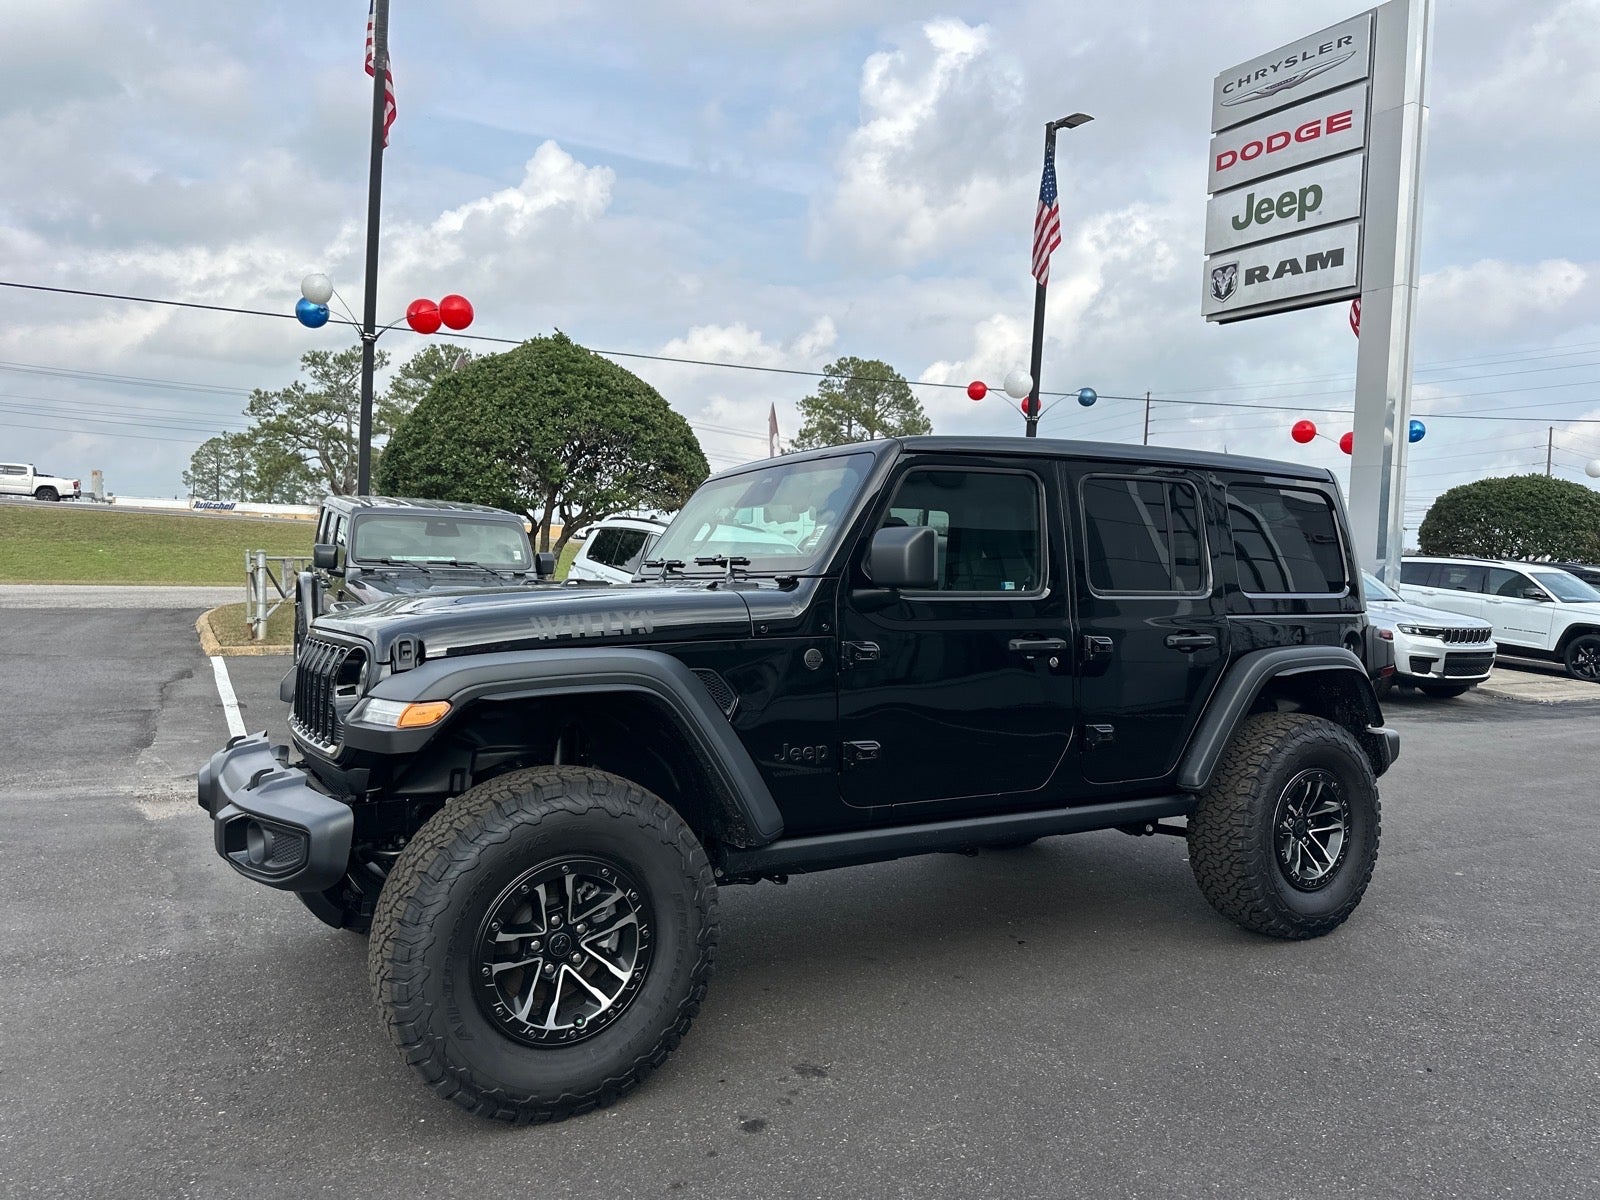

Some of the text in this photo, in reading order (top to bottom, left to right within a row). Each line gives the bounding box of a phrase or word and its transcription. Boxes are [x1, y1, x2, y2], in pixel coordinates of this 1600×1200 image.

[1222, 35, 1353, 94] CHRYSLER
[1216, 110, 1353, 172] DODGE
[1232, 184, 1323, 230] Jeep
[1245, 247, 1345, 286] RAM
[530, 610, 655, 640] WILLYS
[774, 743, 828, 764] Jeep
